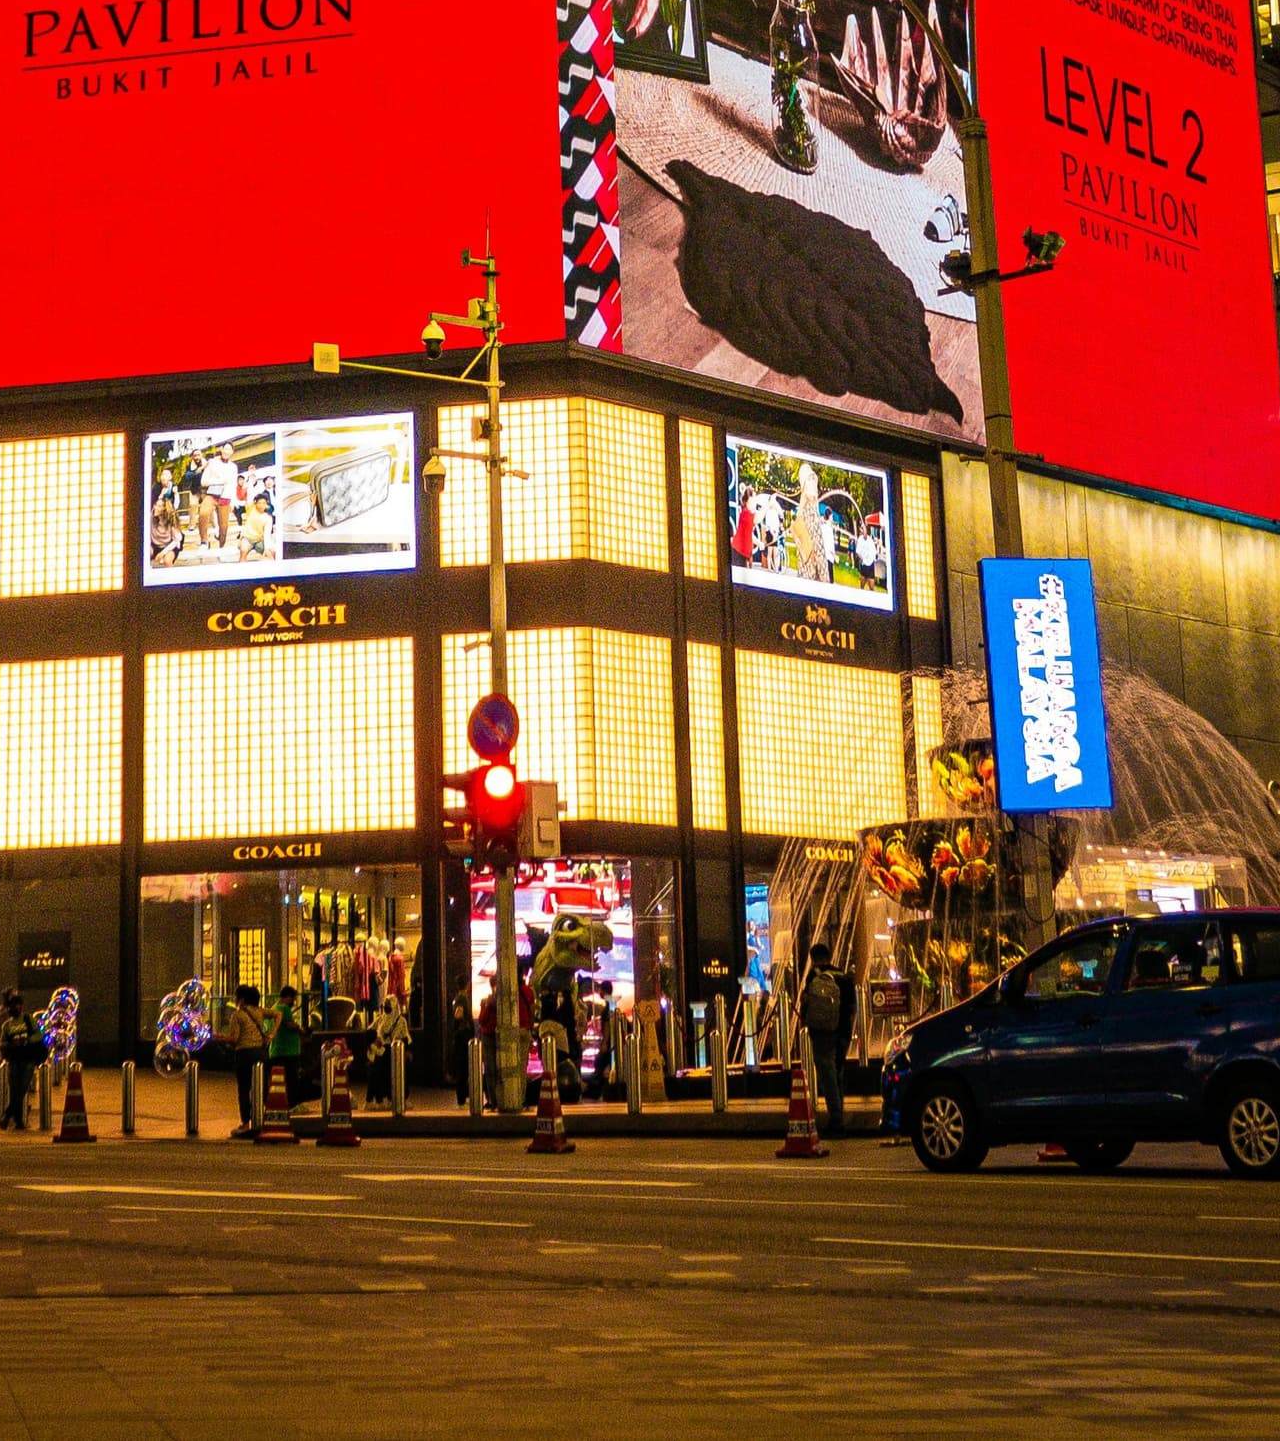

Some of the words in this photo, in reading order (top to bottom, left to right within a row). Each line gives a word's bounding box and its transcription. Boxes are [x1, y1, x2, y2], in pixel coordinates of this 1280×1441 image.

[56, 65, 172, 101] BUKIT
[213, 52, 318, 88] JALIL
[1040, 45, 1168, 168] LEVEL
[1183, 108, 1208, 185] 2
[1061, 151, 1199, 240] PAVILION
[1079, 215, 1130, 254] BUKIT
[1145, 242, 1189, 274] JALIL
[207, 604, 347, 634] COACH
[250, 632, 275, 644] NEW
[276, 631, 303, 643] YORK
[781, 622, 855, 650] COACH
[1012, 598, 1056, 785] MALAYSIA
[233, 843, 322, 860] COACH
[806, 846, 854, 862] COACH
